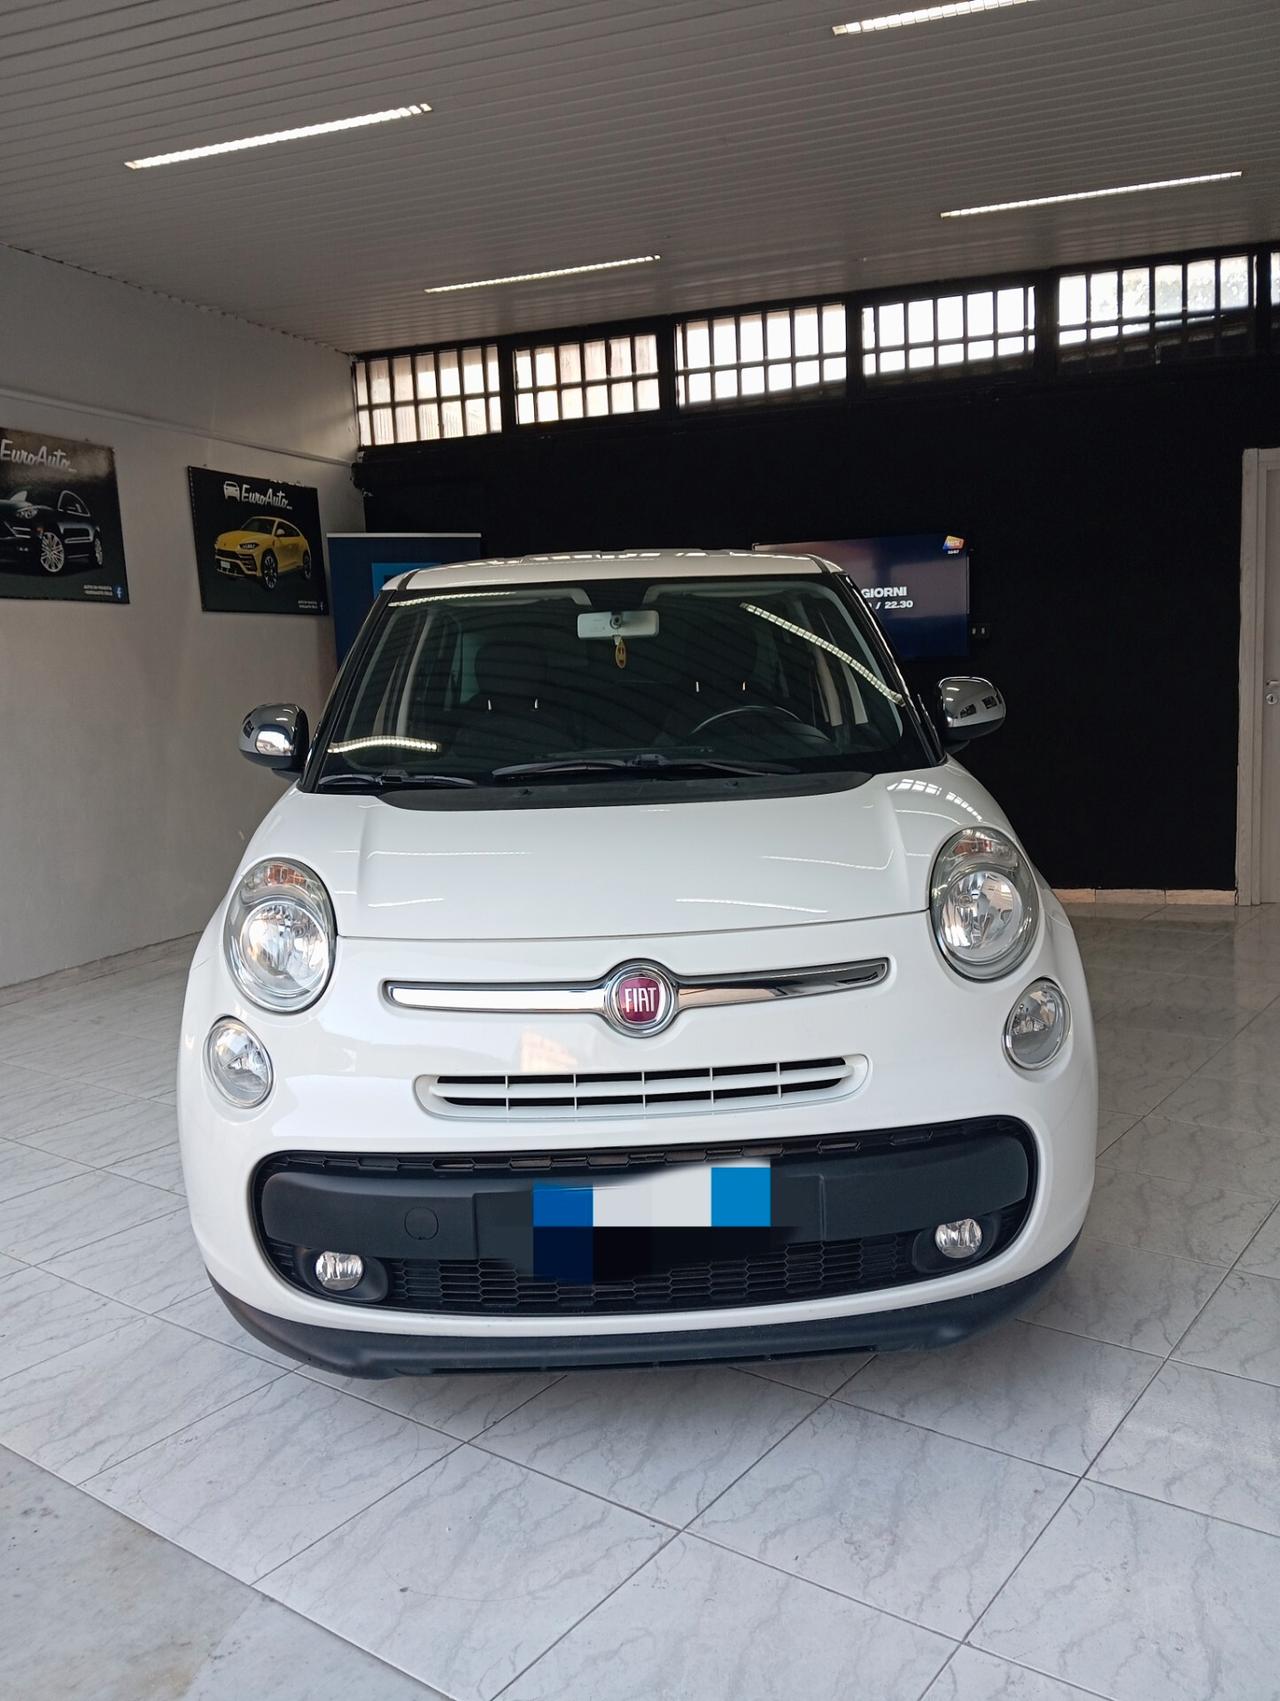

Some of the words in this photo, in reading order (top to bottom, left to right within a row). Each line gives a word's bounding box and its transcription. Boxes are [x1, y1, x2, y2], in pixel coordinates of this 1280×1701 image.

[0, 438, 71, 468] EuroAuto
[241, 483, 289, 508] EuroAuto
[861, 586, 908, 599] GIORNI
[884, 600, 914, 609] 22.30
[624, 987, 657, 1013] FIAT
